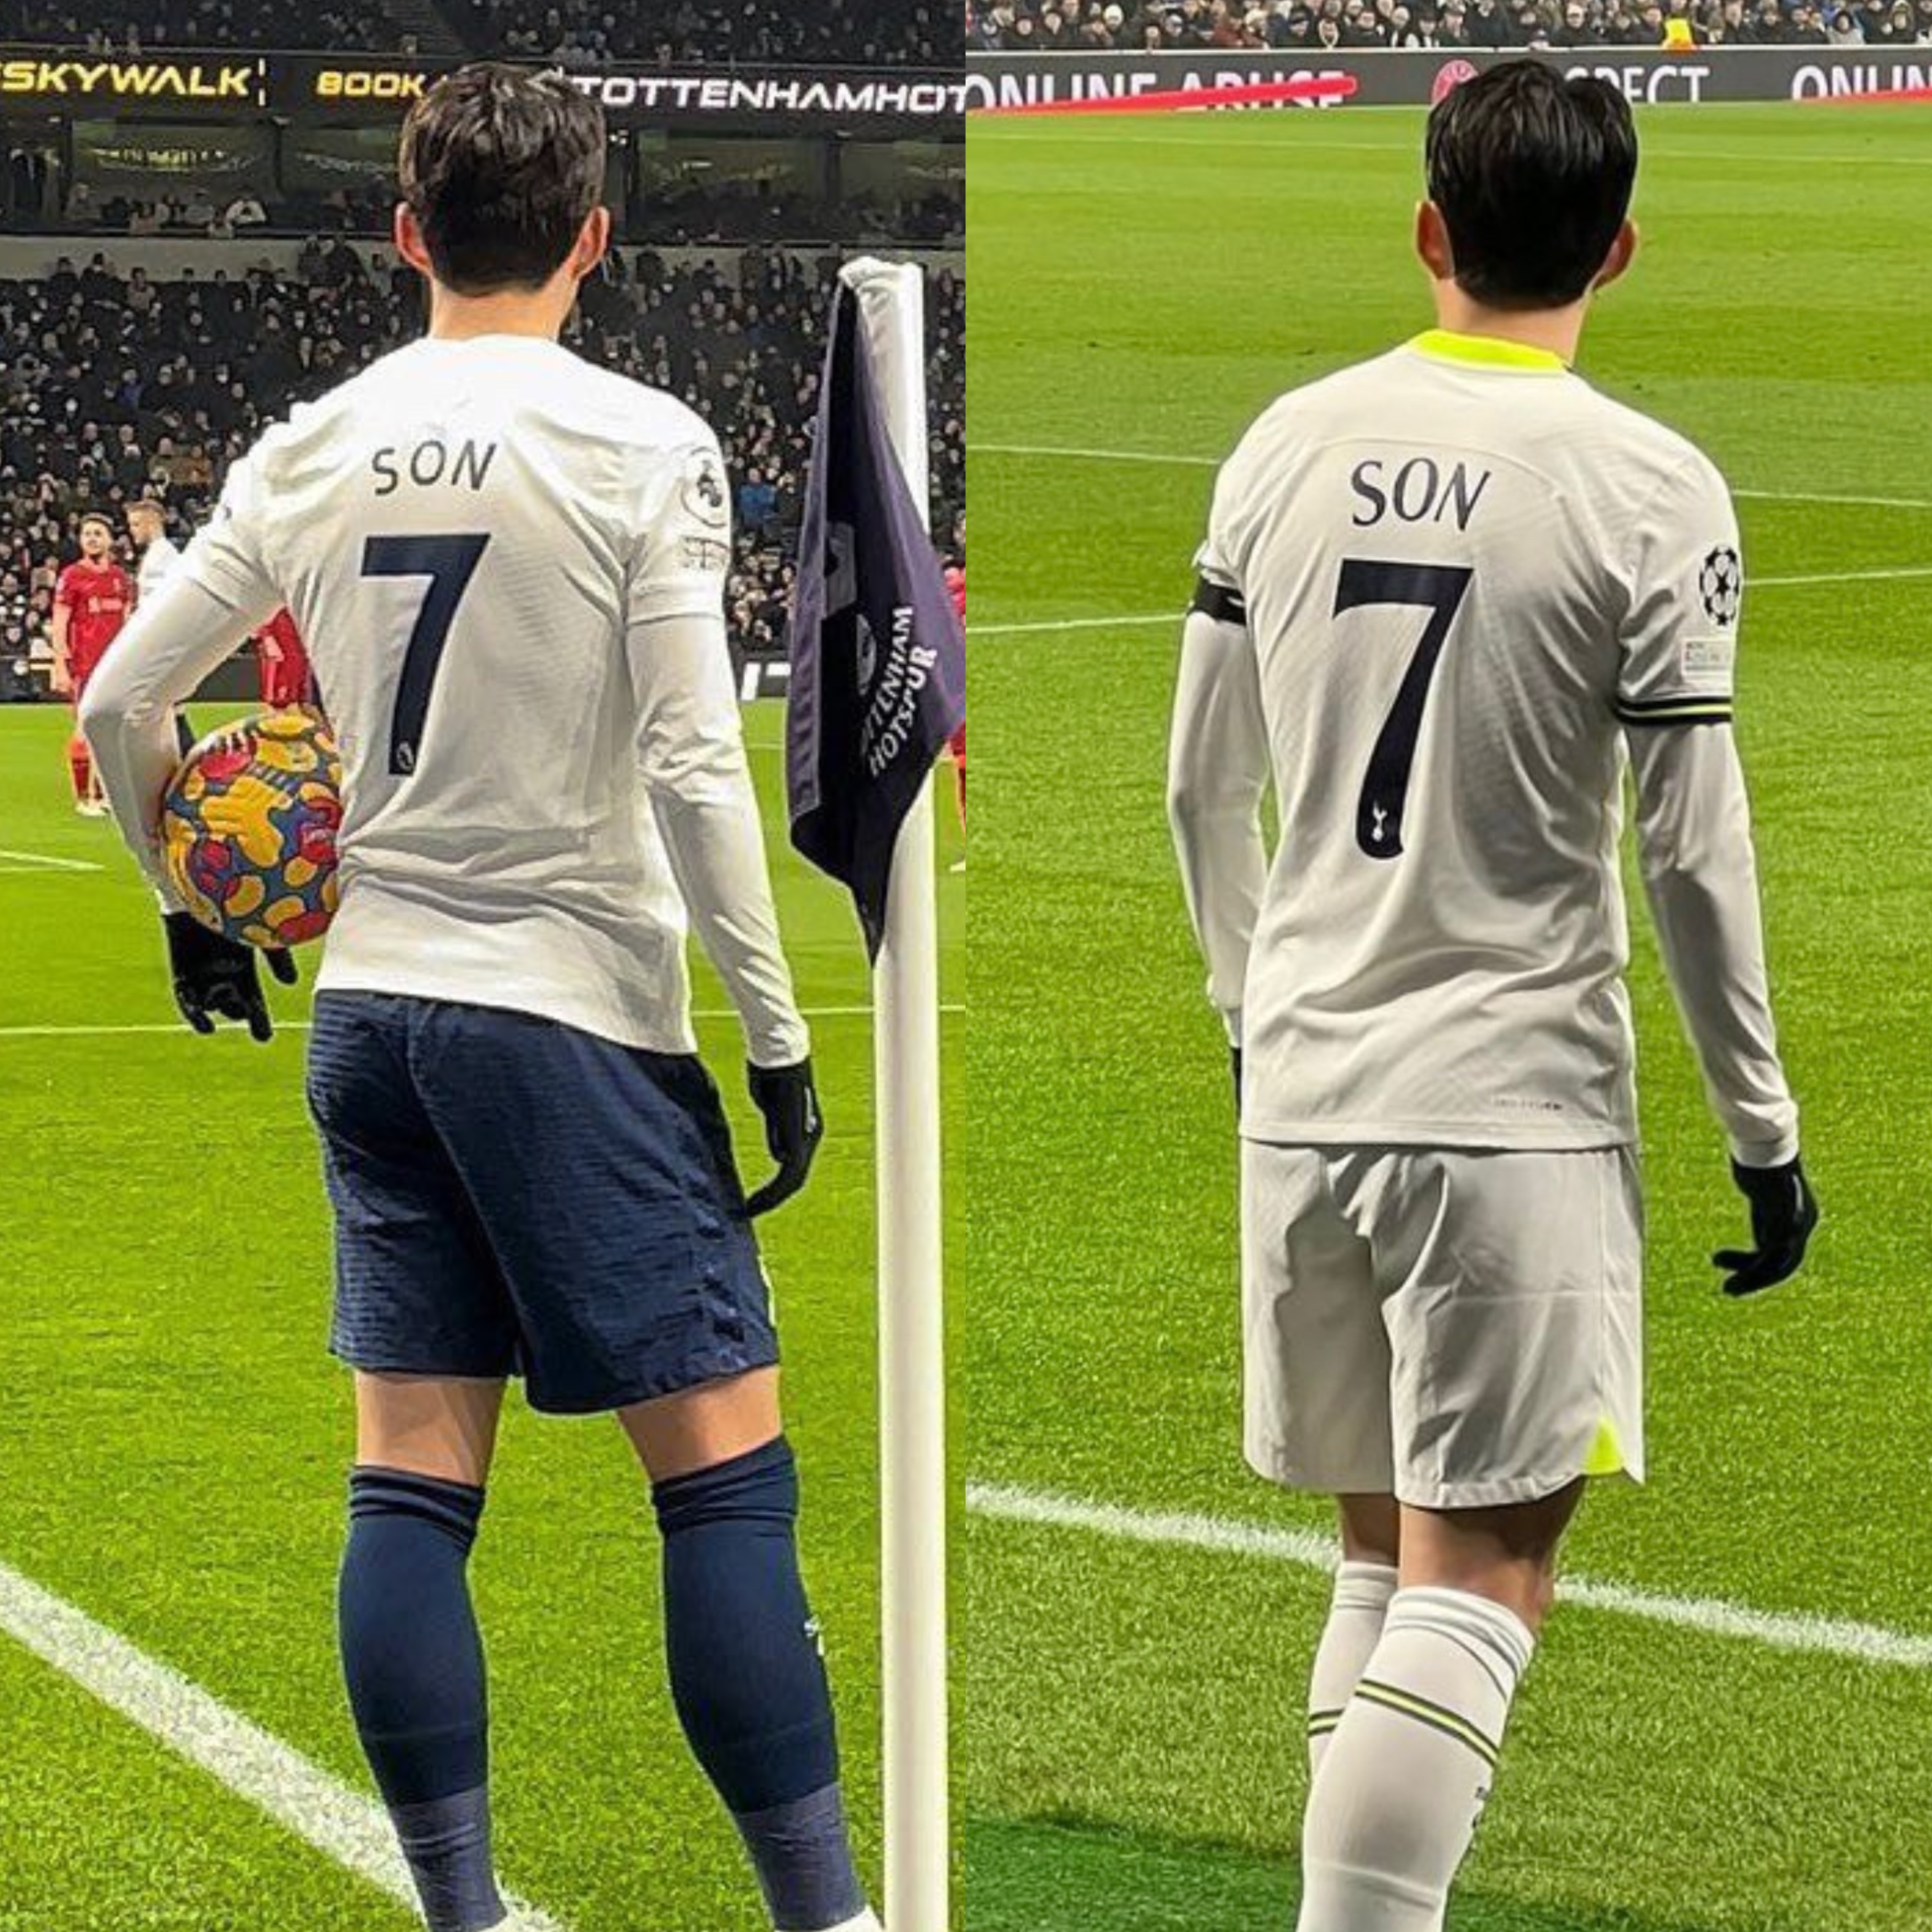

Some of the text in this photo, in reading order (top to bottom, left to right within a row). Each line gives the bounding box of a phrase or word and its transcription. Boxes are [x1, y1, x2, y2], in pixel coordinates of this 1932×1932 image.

[0, 61, 252, 95] SKYWALK
[316, 71, 425, 98] BOOK
[372, 438, 497, 496] SON
[1350, 458, 1491, 531] SON
[361, 533, 491, 775] 7
[1333, 558, 1474, 860] 7
